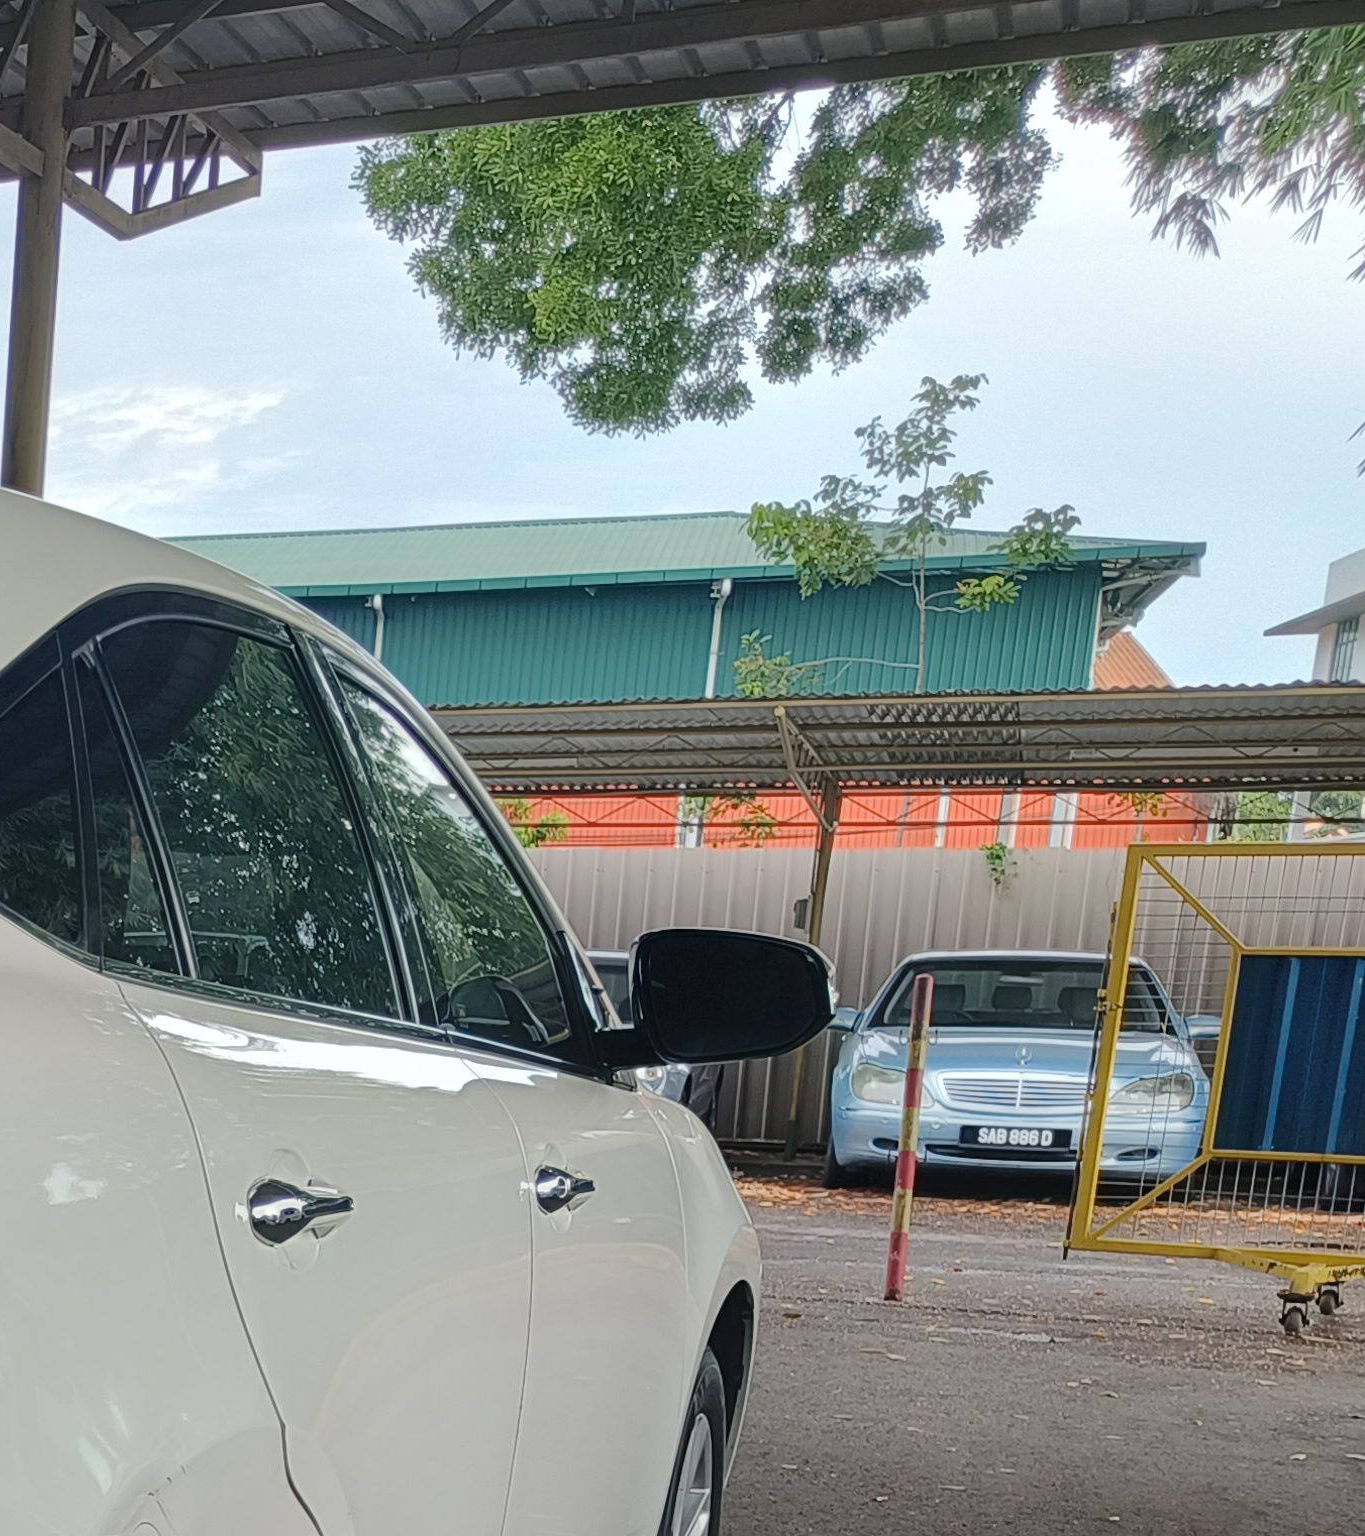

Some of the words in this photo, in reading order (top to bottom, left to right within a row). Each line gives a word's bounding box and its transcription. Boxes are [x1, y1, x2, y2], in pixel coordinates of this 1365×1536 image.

[978, 1127, 1007, 1145] SAB
[1009, 1129, 1039, 1146] 886
[1040, 1130, 1052, 1147] D
